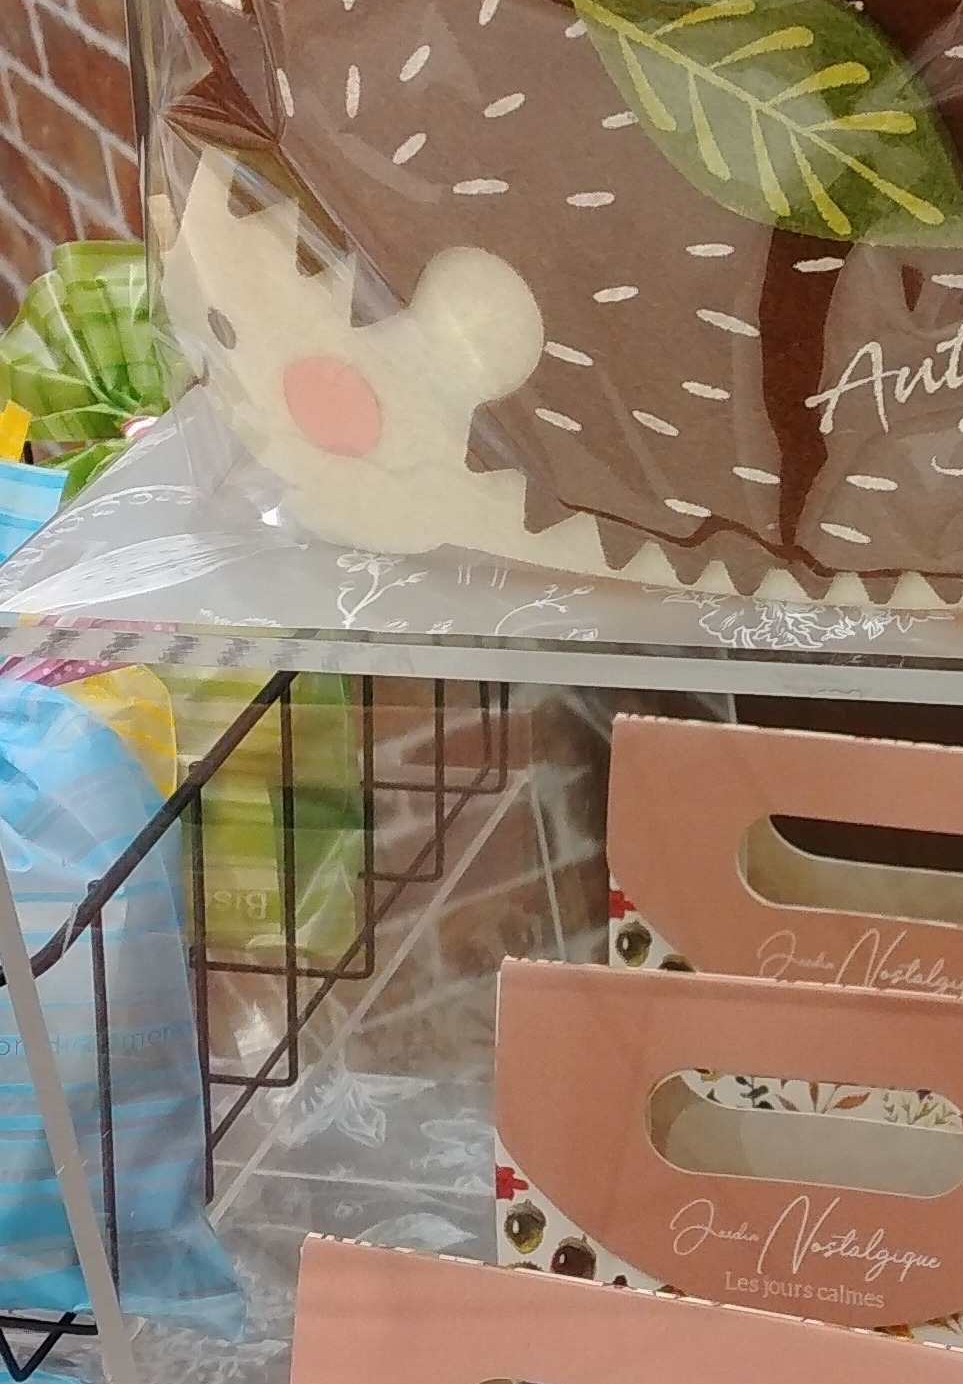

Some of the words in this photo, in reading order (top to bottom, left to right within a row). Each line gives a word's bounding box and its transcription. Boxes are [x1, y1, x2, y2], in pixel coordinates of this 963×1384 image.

[756, 1194, 941, 1282] Nostalgique
[725, 1271, 759, 1293] Les
[763, 1277, 814, 1299] jours
[818, 1284, 886, 1309] calmes
